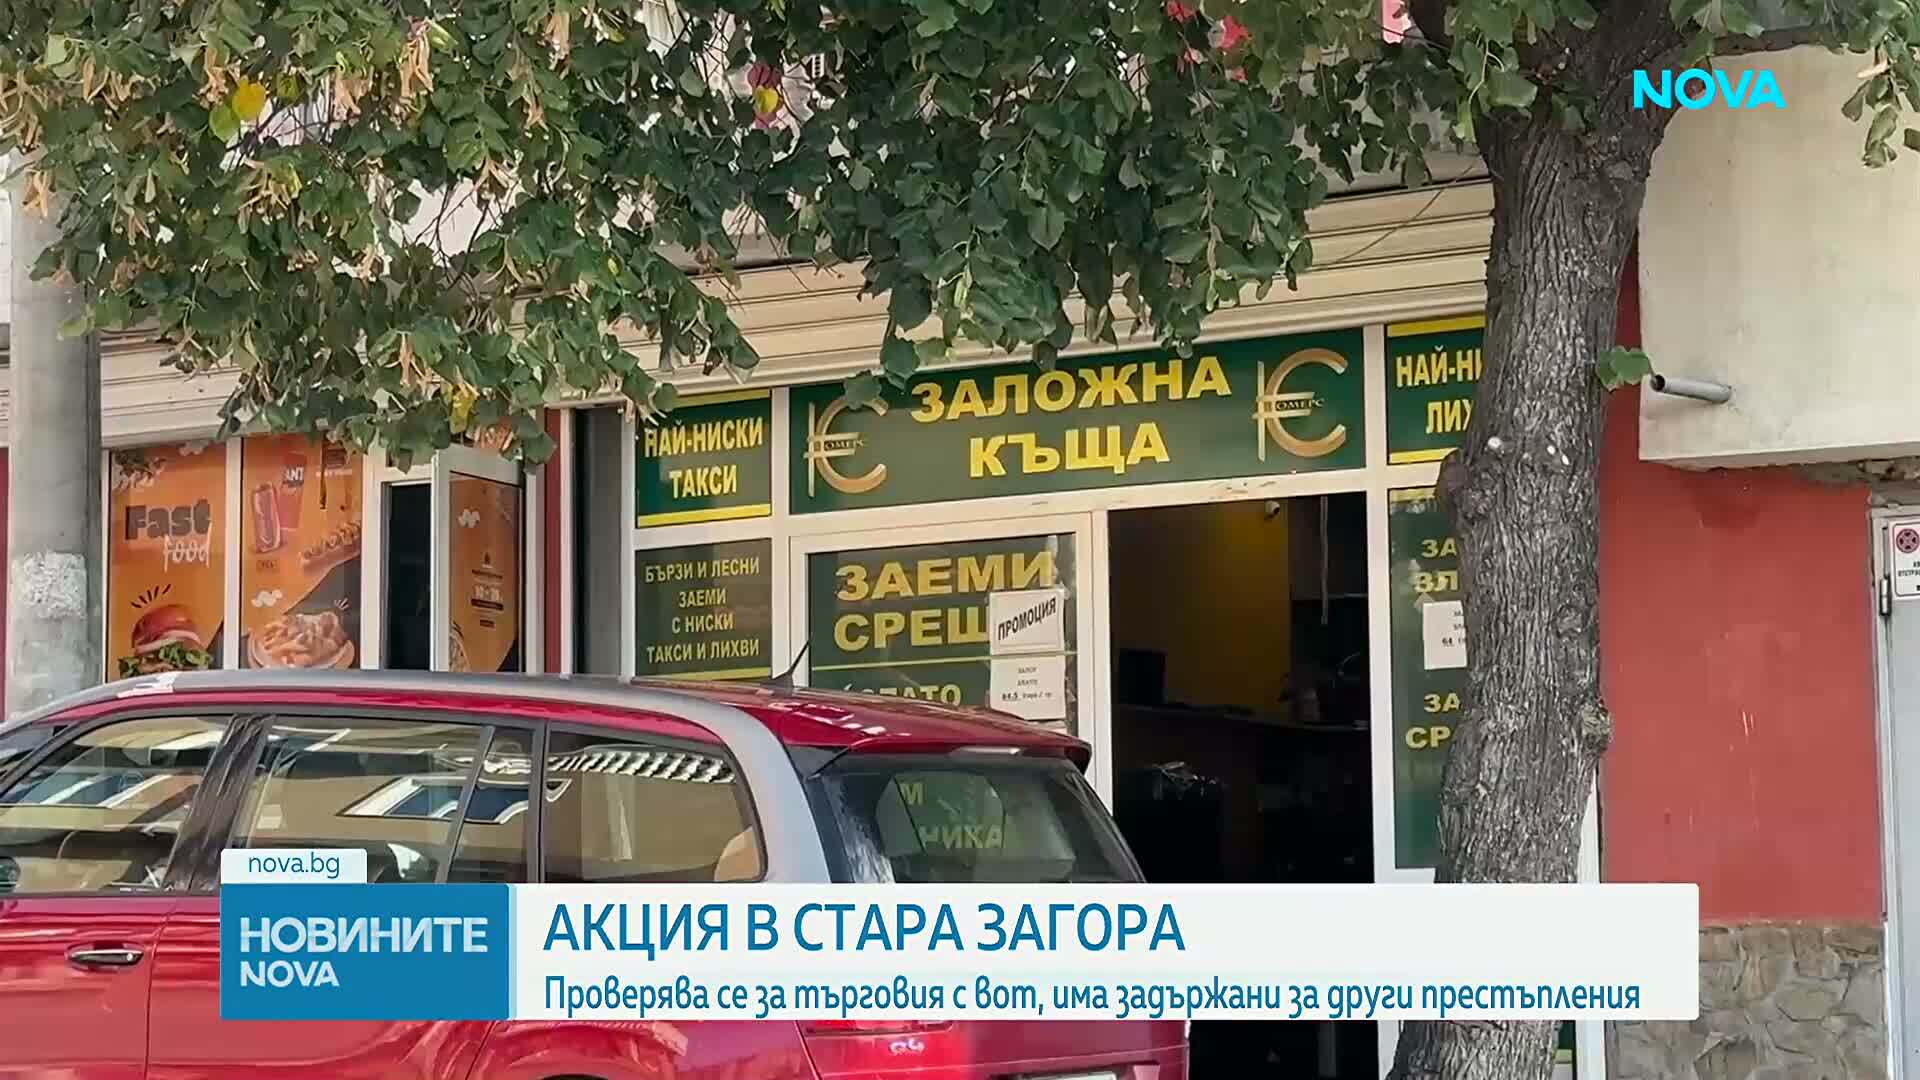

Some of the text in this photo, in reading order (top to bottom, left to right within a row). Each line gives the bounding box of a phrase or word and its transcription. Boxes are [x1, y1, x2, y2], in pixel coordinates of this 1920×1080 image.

[1396, 345, 1483, 388] НАЙ-Н
[910, 356, 1232, 423] ЗАЛОЖНА
[644, 416, 763, 458] НАЙ-НИСКИ
[970, 422, 1170, 479] КЪЩА
[669, 464, 737, 499] ТАКСИ
[125, 498, 212, 540] Fast
[162, 522, 213, 573] food
[645, 557, 760, 583] БЪРЗИ И ЛЕСНИ
[835, 551, 1054, 602] ЗАЕМИ
[679, 588, 726, 608] ЗАЕМИ
[998, 597, 1057, 641] ПРОМОЦИЯ
[671, 612, 734, 634] С НИСКИ
[646, 638, 760, 664] ТАКСИ И ЛИХВИ
